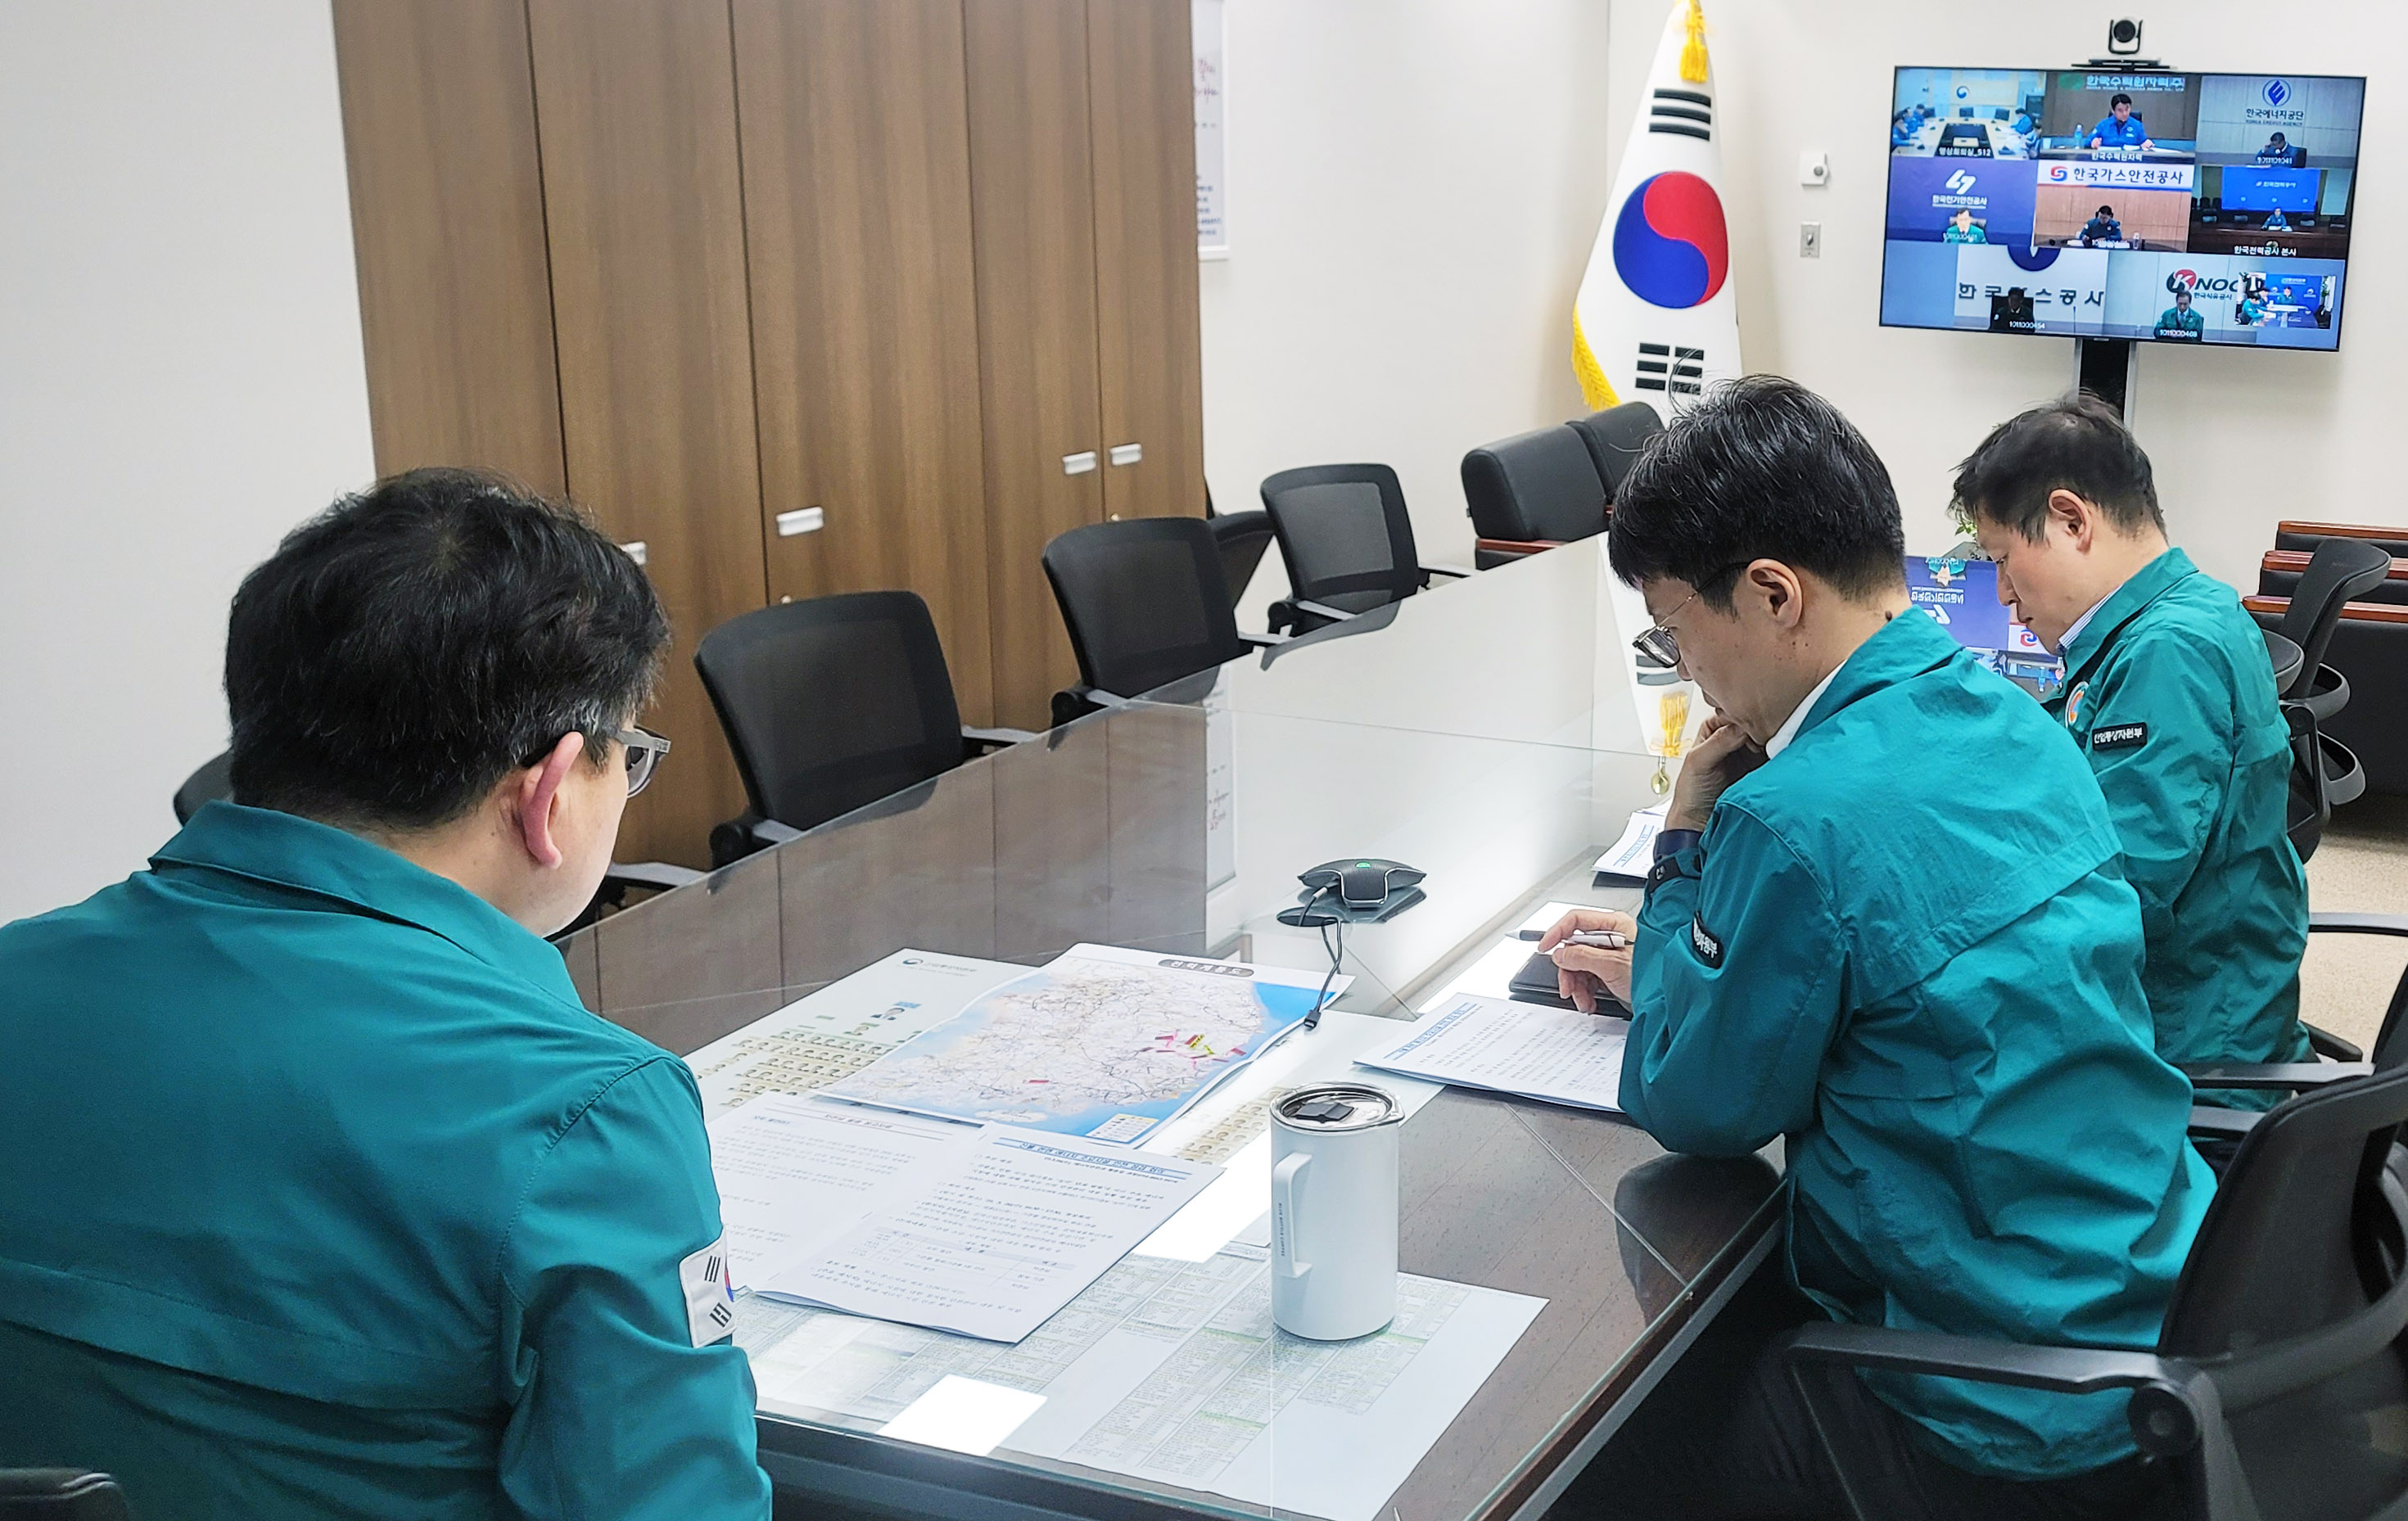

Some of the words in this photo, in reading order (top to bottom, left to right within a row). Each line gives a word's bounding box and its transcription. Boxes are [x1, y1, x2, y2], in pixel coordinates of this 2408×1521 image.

[2246, 108, 2304, 120] 한국에너지공단
[2074, 167, 2184, 185] 한국가스안전공사
[1932, 194, 1987, 205] 한국전기안전공사
[2234, 245, 2279, 255] 한국전력공사
[2281, 247, 2297, 256] 본사
[2194, 291, 2233, 300] 한국석유공사
